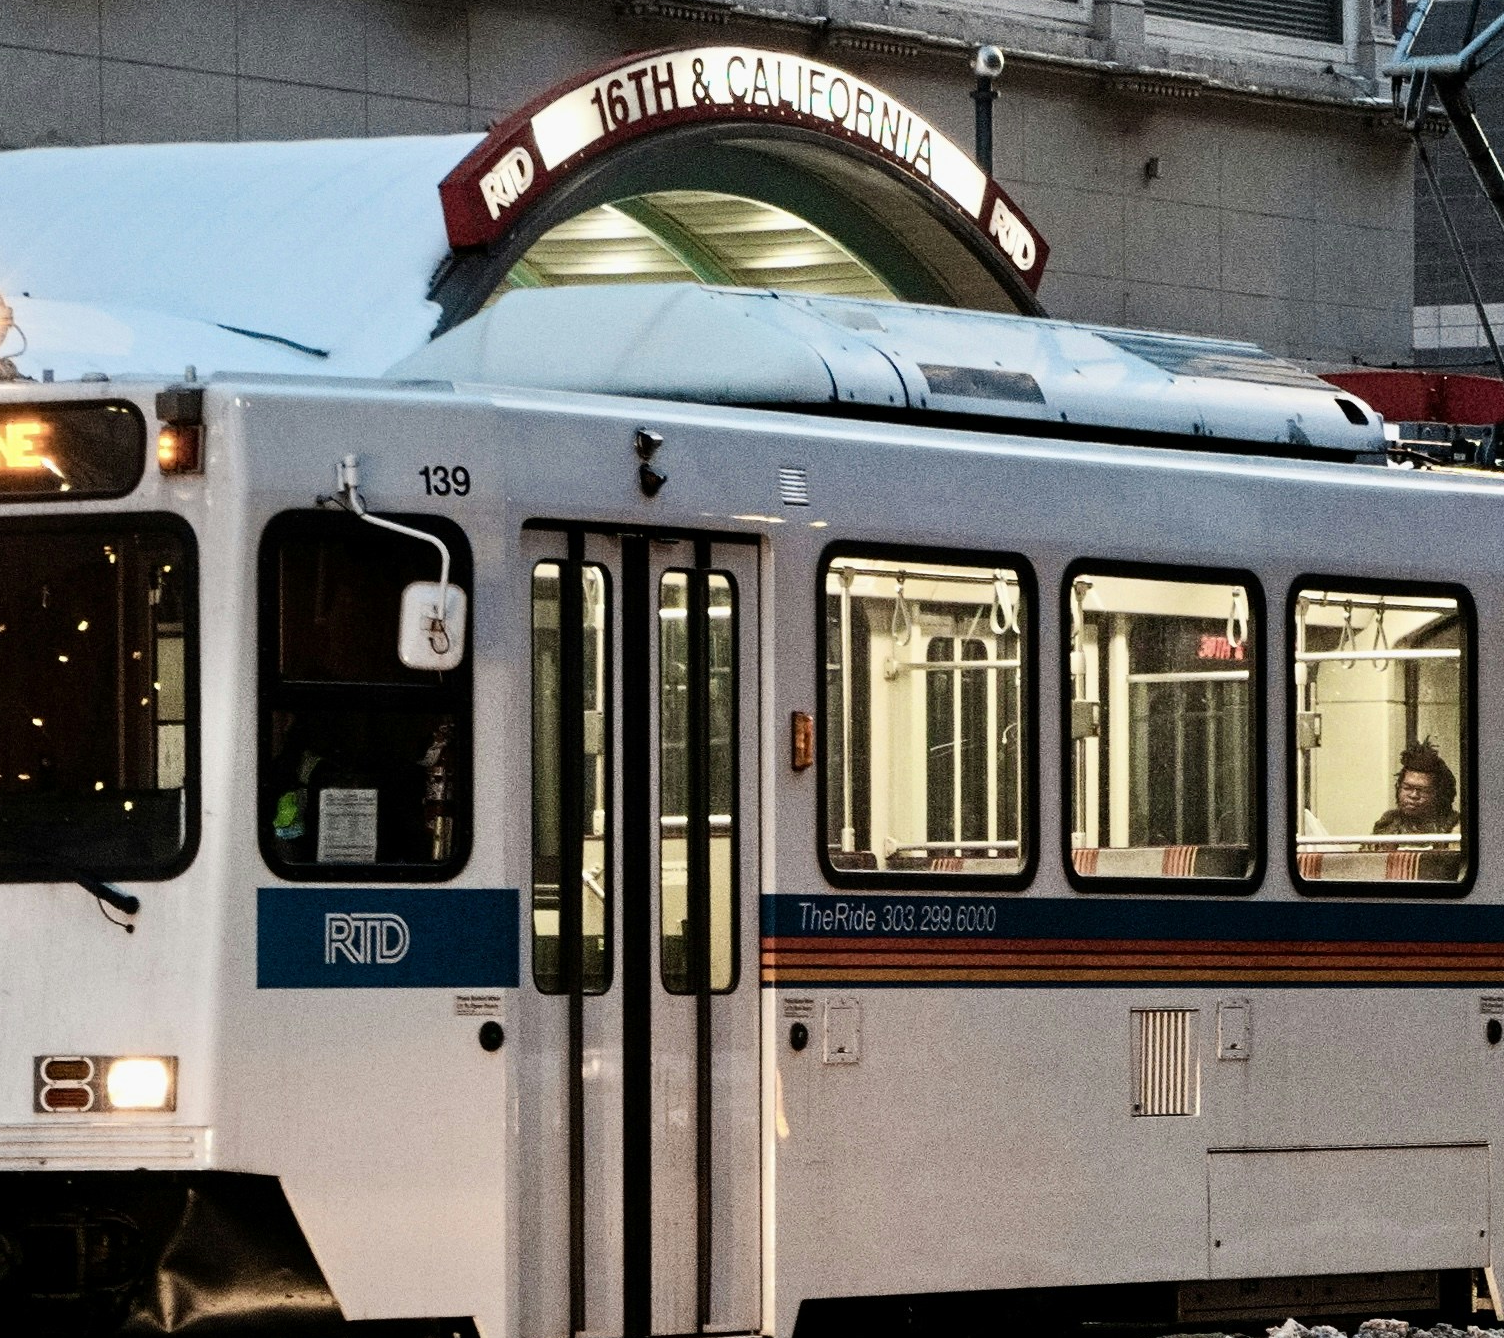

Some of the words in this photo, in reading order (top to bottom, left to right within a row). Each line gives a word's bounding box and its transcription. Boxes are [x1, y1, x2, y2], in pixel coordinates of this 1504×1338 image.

[477, 145, 535, 221] RTD
[590, 61, 680, 132] 16TH
[690, 57, 711, 101] &
[727, 54, 936, 174] CALIFORNIA
[987, 195, 1037, 271] RTD
[418, 466, 471, 497] 139
[798, 901, 876, 932] TheRide
[881, 903, 998, 933] 303.299.6000
[324, 913, 411, 965] RTD
